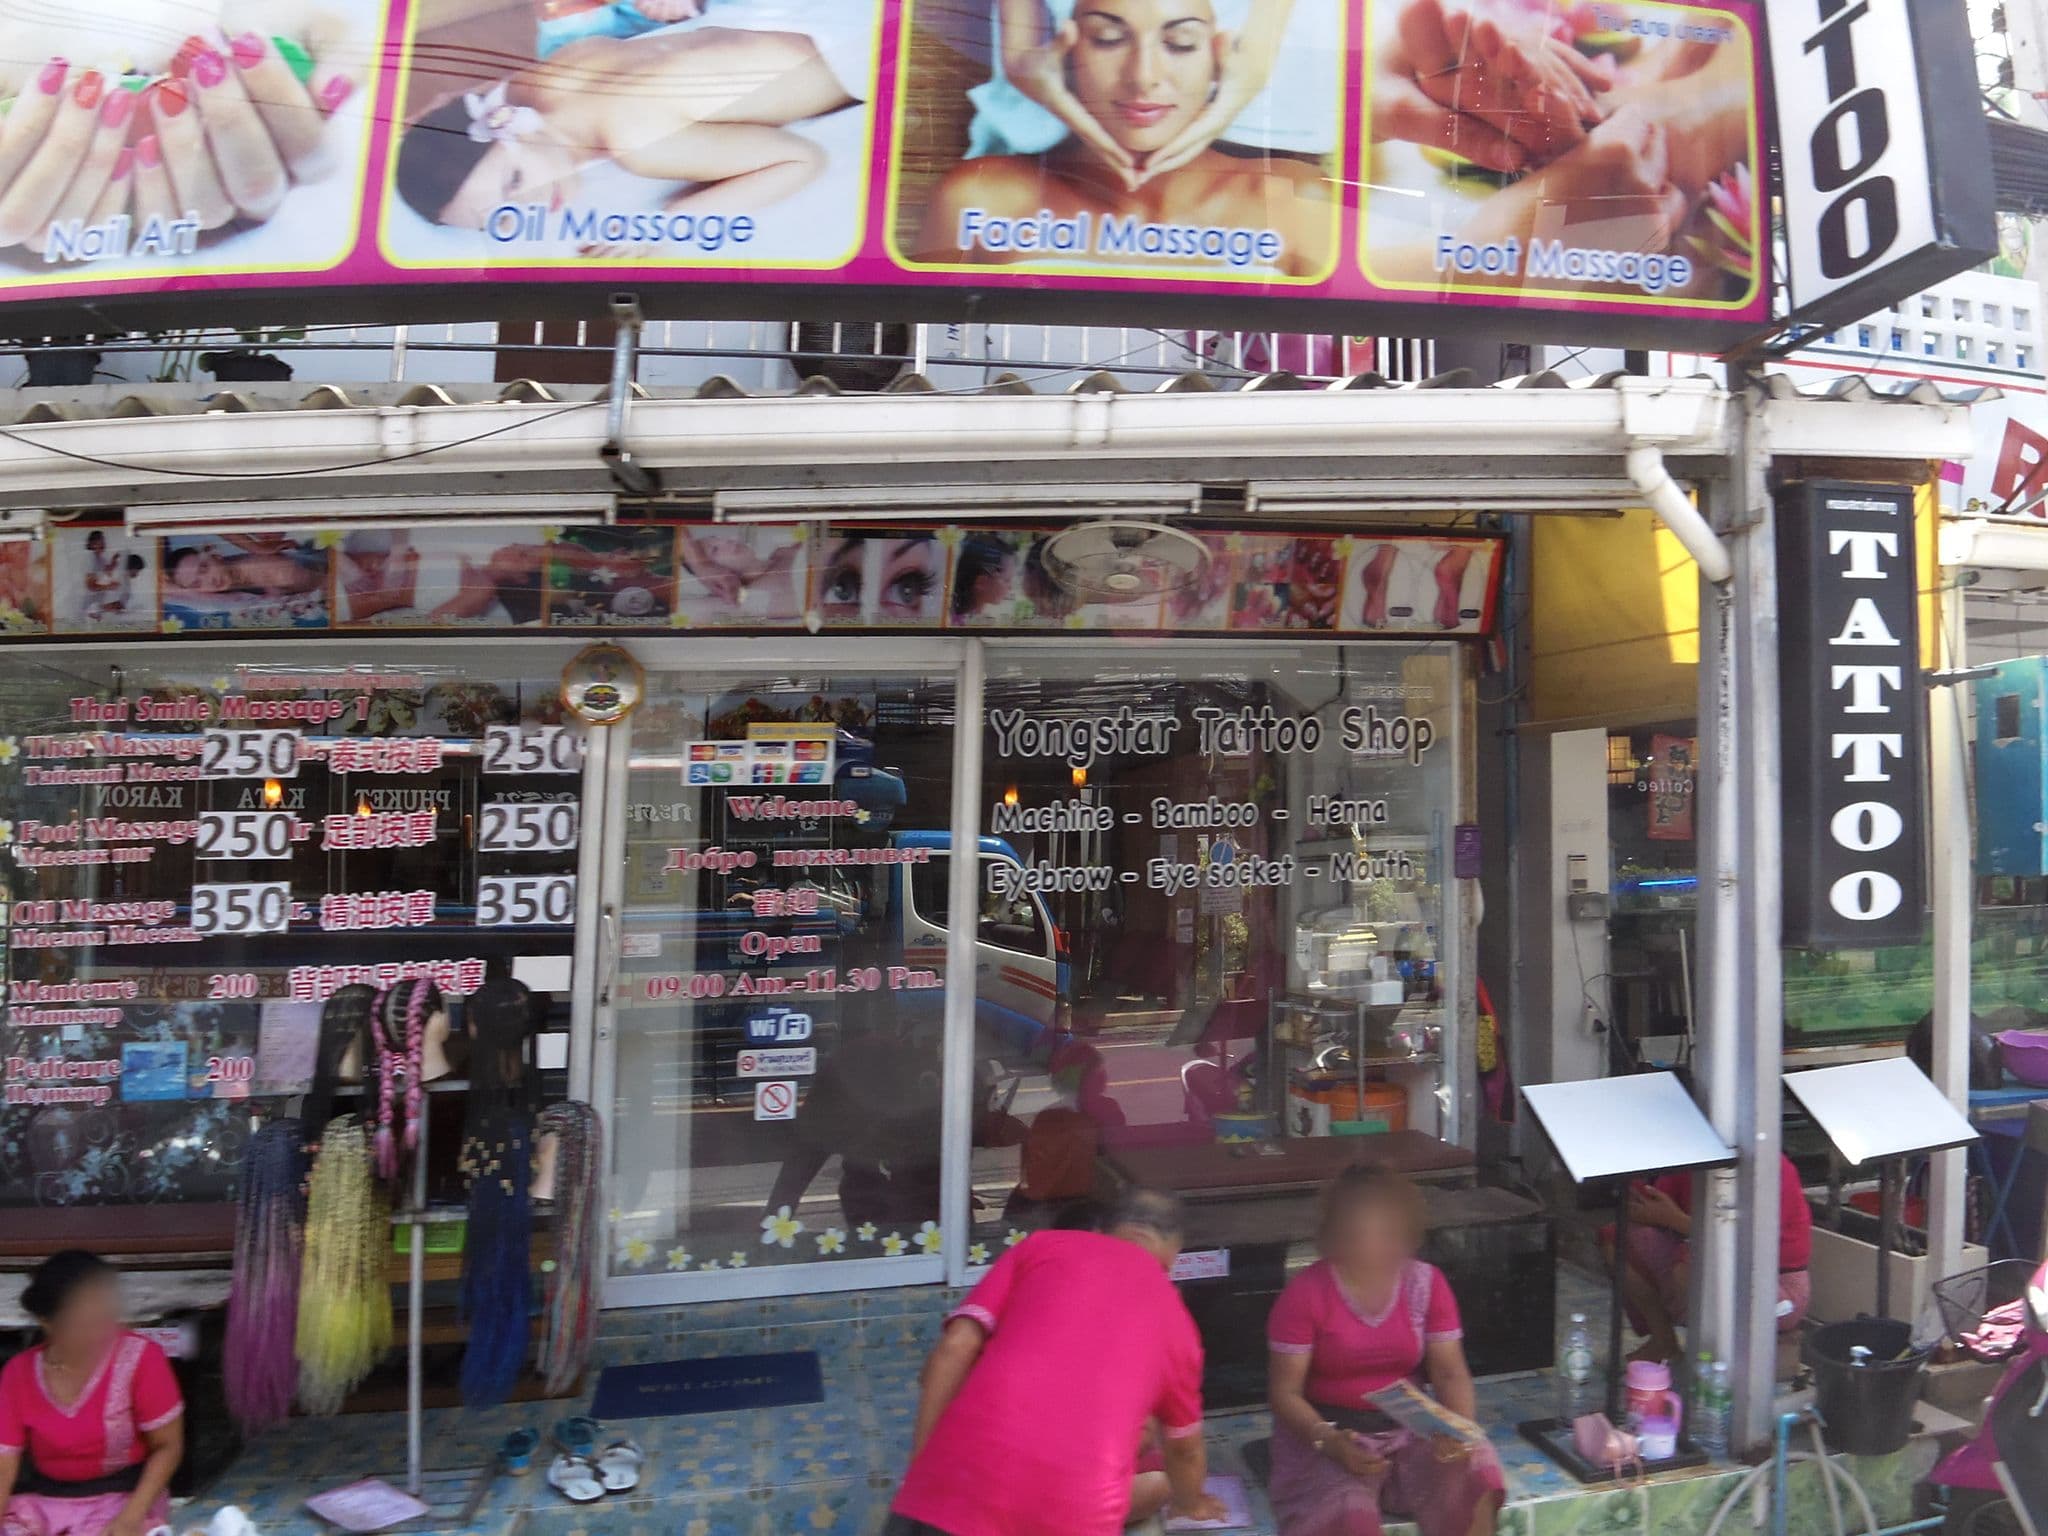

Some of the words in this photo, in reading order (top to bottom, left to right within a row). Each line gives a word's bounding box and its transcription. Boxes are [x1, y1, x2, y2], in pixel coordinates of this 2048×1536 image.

[46, 218, 132, 263] Nail
[136, 210, 202, 258] Art
[488, 204, 545, 243] Oil
[557, 207, 756, 252] Massage
[958, 208, 1091, 253] Facial
[1098, 211, 1284, 265] Massage
[1434, 233, 1521, 278] Foot
[1527, 239, 1692, 290] Massage
[70, 697, 129, 723] Thai
[135, 696, 210, 722] Smile
[218, 694, 344, 725] Massage
[1828, 529, 1903, 921] TATTOO
[24, 735, 89, 760] Thai
[90, 733, 205, 761] Massage
[204, 732, 297, 776] 250
[328, 736, 443, 774] 泰式按摩
[989, 705, 1182, 770] Yongstar
[1192, 705, 1324, 755] Tattoo
[1339, 706, 1437, 766] Shop
[483, 805, 575, 848] 250
[727, 795, 859, 818] Welcome
[991, 798, 1114, 834] Machine
[1151, 798, 1259, 829] Bamboo
[1306, 795, 1388, 826] Henna
[17, 819, 79, 844] Foot
[84, 817, 200, 844] Massage
[200, 813, 292, 858] 250
[321, 810, 438, 851] 足部按摩
[661, 847, 758, 875] Добро
[987, 859, 1114, 894] Eyebrow
[1146, 858, 1197, 896] Eye
[1205, 854, 1297, 886] socket
[1329, 851, 1415, 882] Mouth
[13, 899, 56, 925] Oil
[60, 897, 177, 925] Massage
[193, 886, 288, 932] 350
[319, 889, 437, 930] 精油按摩
[480, 880, 573, 924] 350
[740, 931, 820, 961] Open
[8, 978, 139, 1003] Manicure
[208, 974, 260, 999] 200
[645, 973, 726, 999] 09.00
[886, 966, 945, 990] Pm.
[5, 1056, 122, 1080] Pedicure
[206, 1056, 255, 1082] 200
